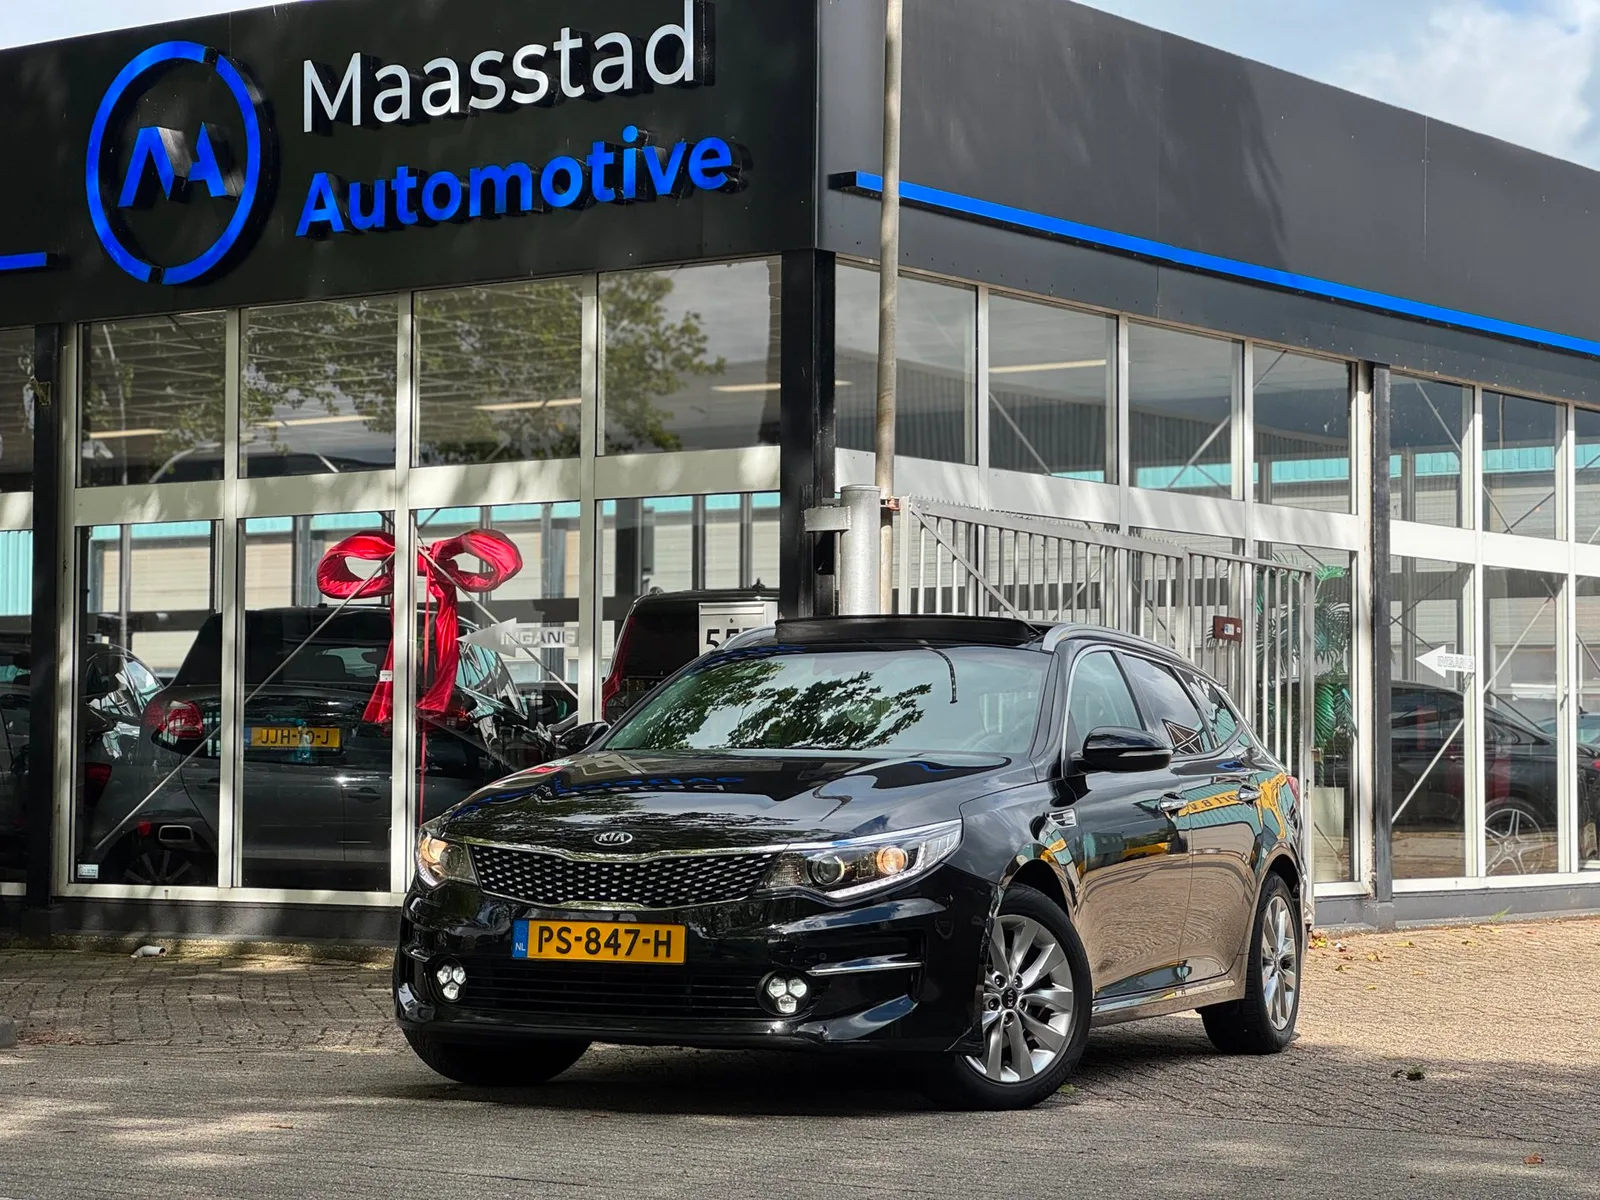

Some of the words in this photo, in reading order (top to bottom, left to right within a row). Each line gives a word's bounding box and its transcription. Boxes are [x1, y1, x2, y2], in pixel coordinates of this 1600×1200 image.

[303, 0, 695, 133] Maasstad
[295, 125, 732, 237] Automotive
[500, 630, 577, 646] INGANG
[515, 942, 526, 951] NL
[537, 925, 672, 958] PS-847-H
